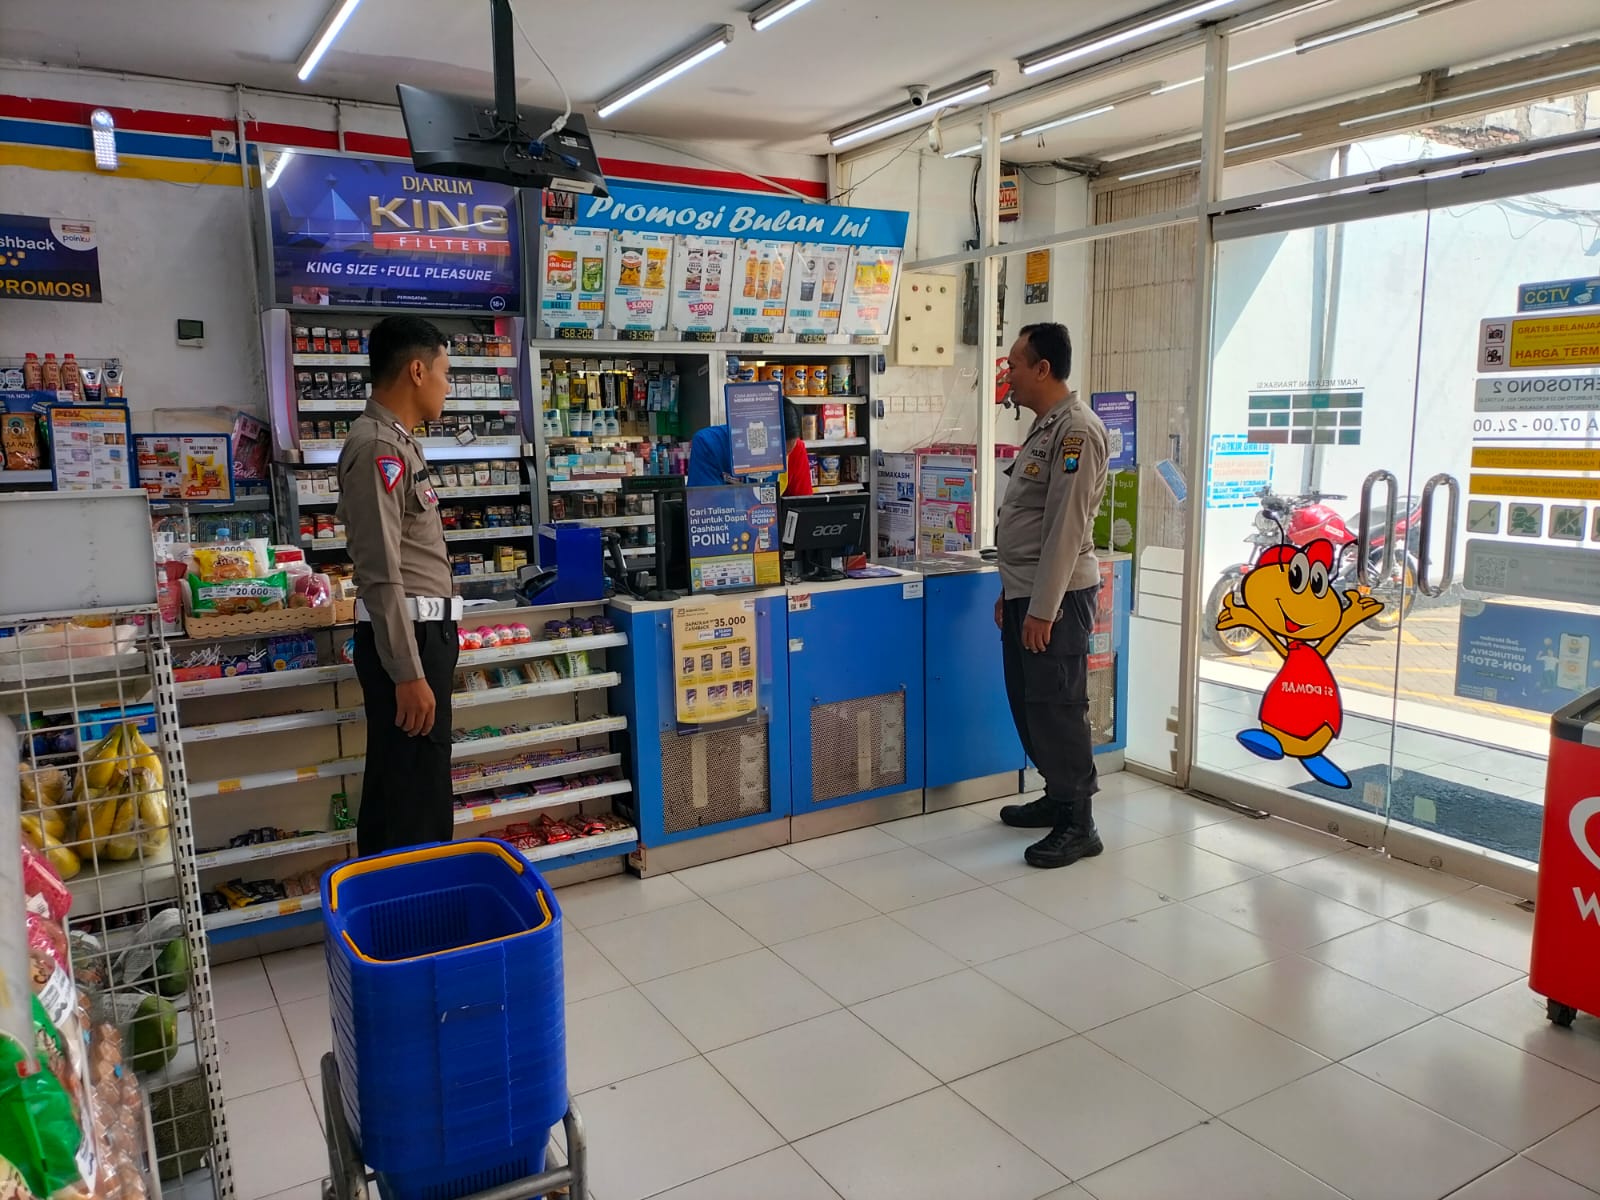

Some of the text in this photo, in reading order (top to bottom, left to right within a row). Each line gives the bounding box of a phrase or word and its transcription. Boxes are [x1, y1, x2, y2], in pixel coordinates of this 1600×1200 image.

[402, 175, 474, 196] DJARUM
[368, 195, 509, 235] KING
[586, 196, 870, 239] Promosi Bulan Ini
[400, 236, 488, 252] FILTER
[306, 261, 493, 281] KING SIZE FULL PLEASURE
[1524, 287, 1570, 304] CCTV
[1518, 325, 1550, 335] GRATIS
[1515, 348, 1559, 359] HARGA
[690, 506, 736, 517] Cari Tulisan
[690, 514, 748, 526] ini untuk Dapat
[690, 524, 729, 534] Cashback
[812, 523, 848, 537] acer
[691, 534, 731, 547] POIN!
[236, 587, 269, 596] 20.000
[714, 615, 746, 628] 35.000
